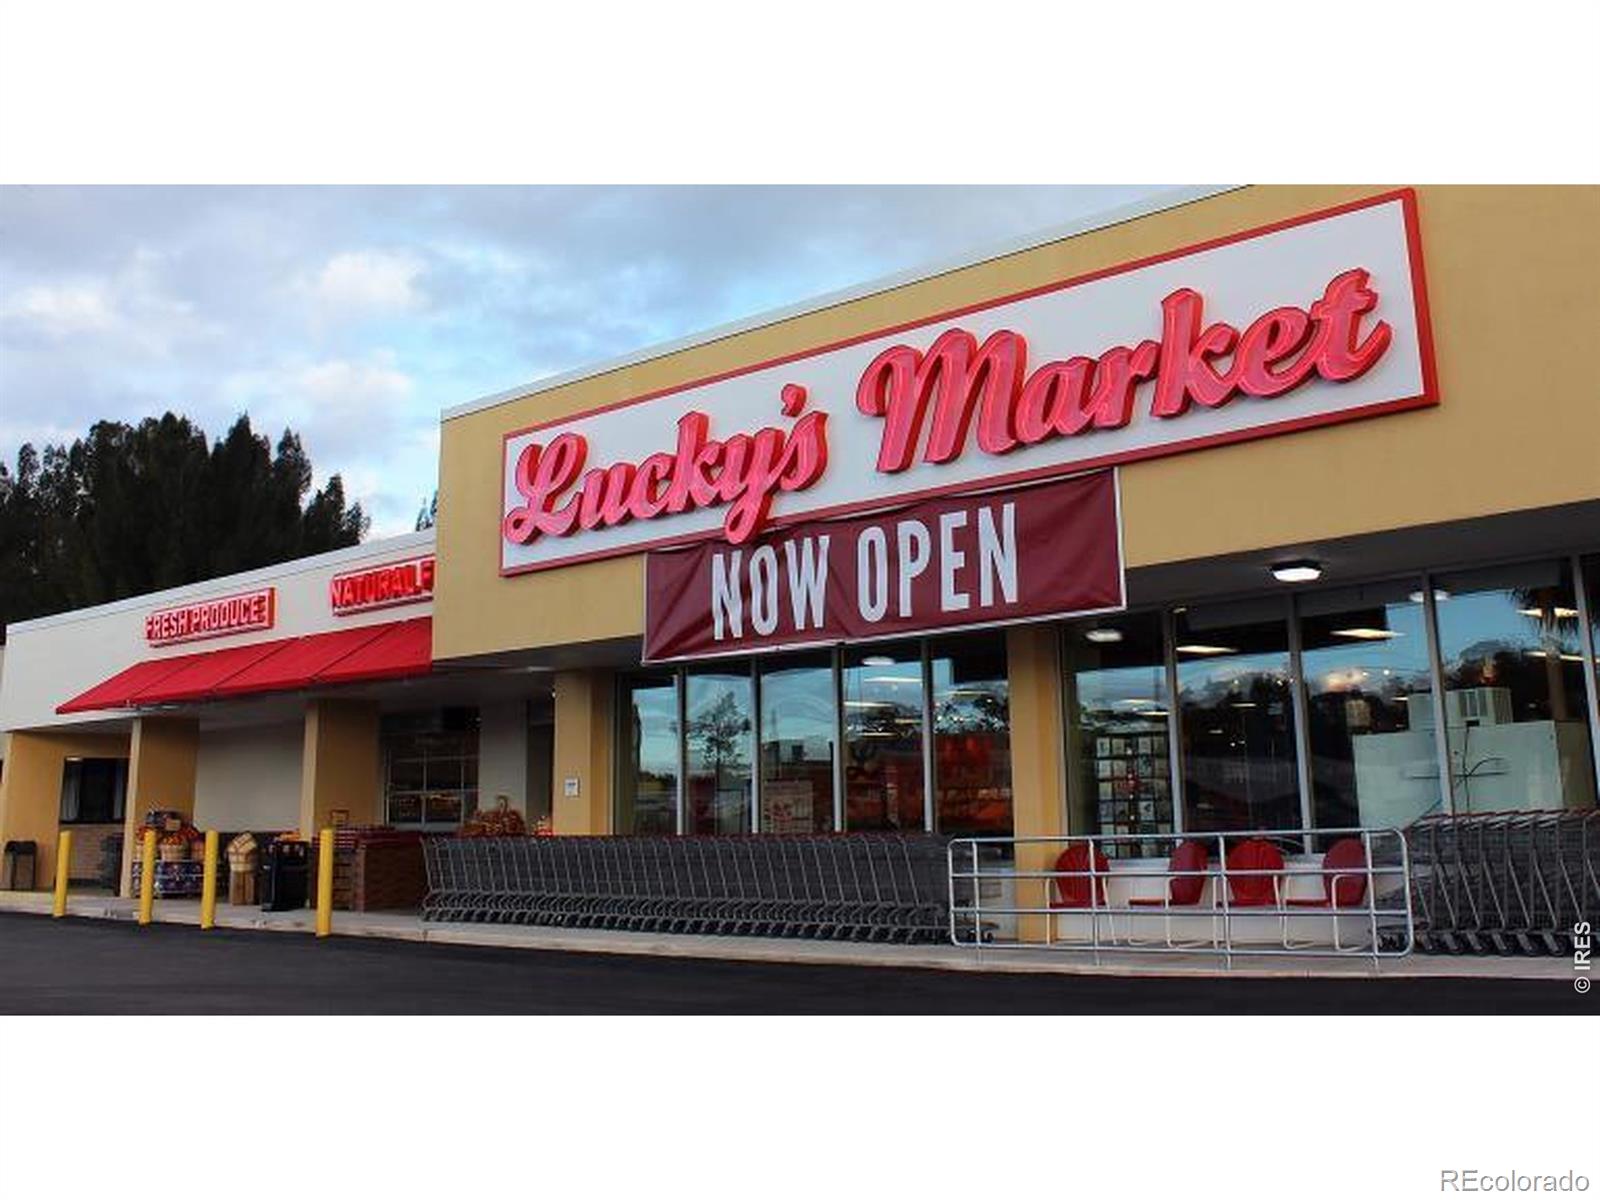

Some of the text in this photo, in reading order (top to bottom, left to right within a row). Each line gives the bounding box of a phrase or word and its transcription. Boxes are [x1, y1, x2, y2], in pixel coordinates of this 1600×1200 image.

[503, 267, 1392, 544] Lucky's Market
[332, 562, 421, 605] NATURAL
[711, 502, 1019, 640] NOW OPEN
[145, 595, 265, 641] FRESH PRODUCE
